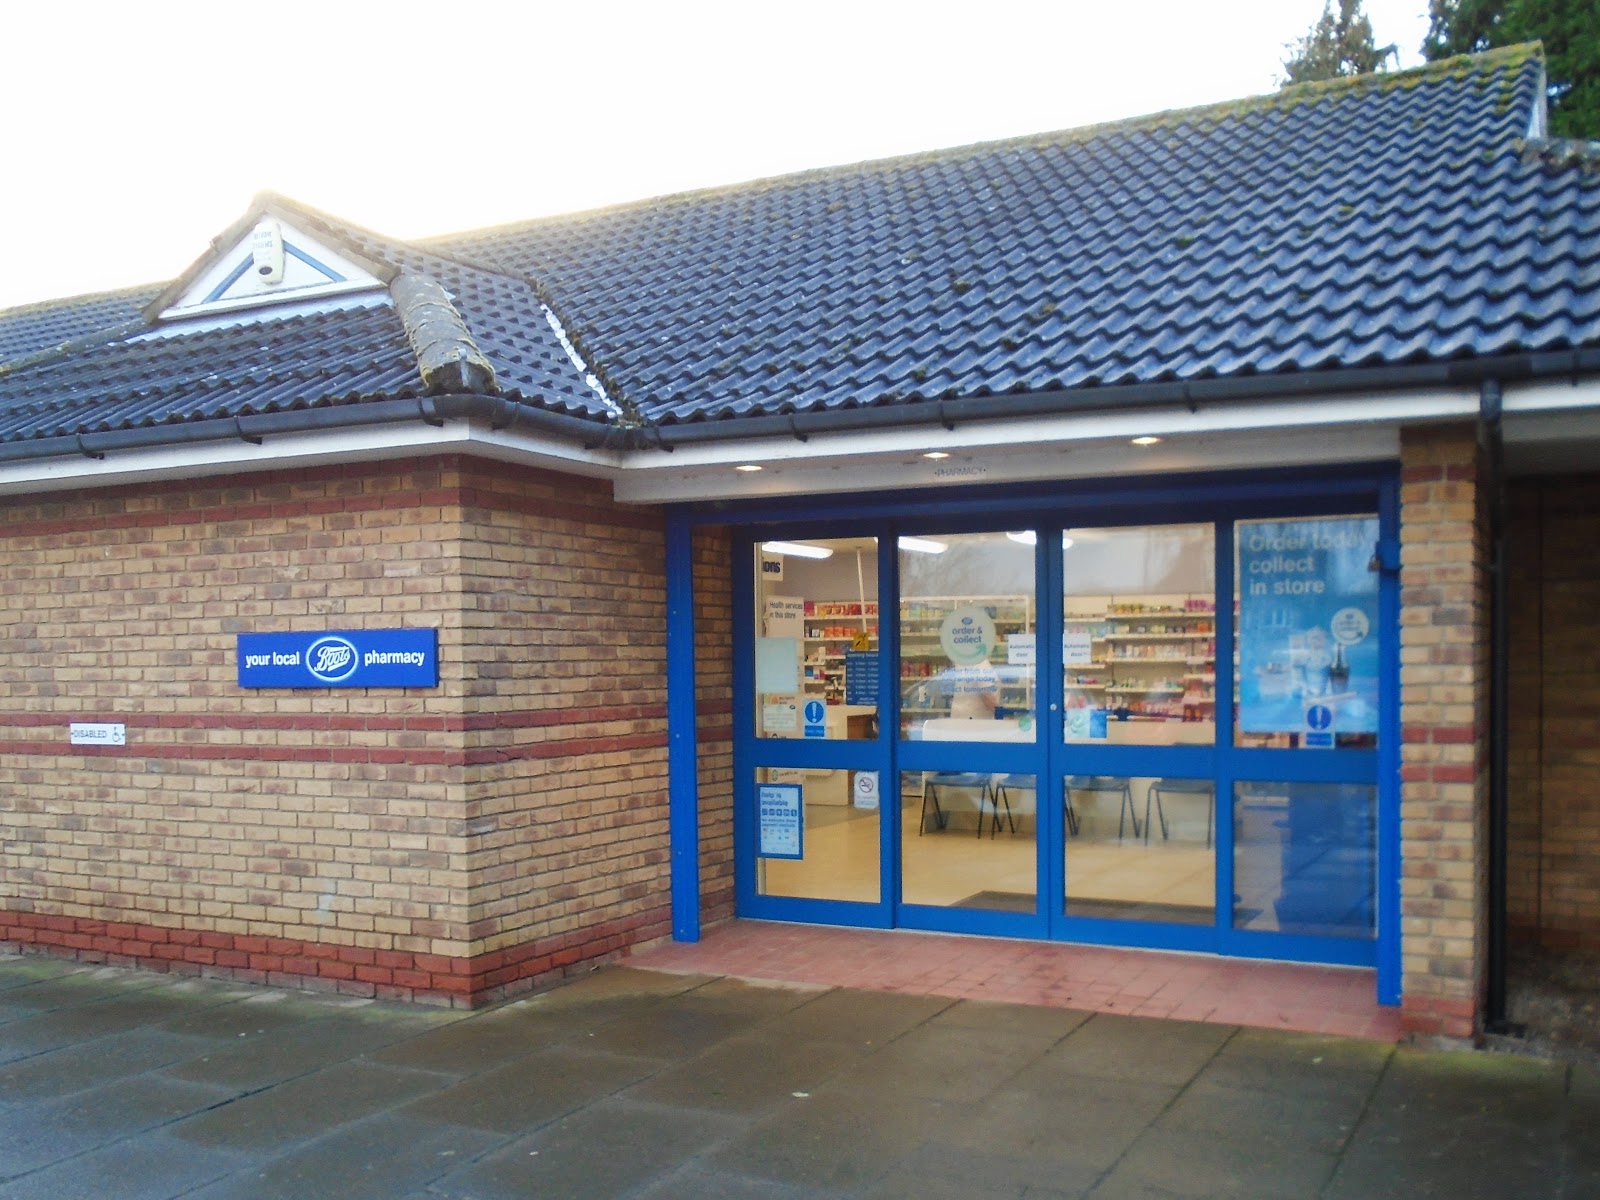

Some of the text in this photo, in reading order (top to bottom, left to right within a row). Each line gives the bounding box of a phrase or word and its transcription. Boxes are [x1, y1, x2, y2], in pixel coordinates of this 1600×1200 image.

[936, 466, 982, 477] PHARMACY
[1249, 555, 1315, 574] collect
[1249, 578, 1326, 596] in store
[951, 626, 983, 635] order &
[953, 635, 983, 644] collect
[245, 645, 426, 673] your local Boots pharmacy
[73, 729, 108, 739] DISABLED
